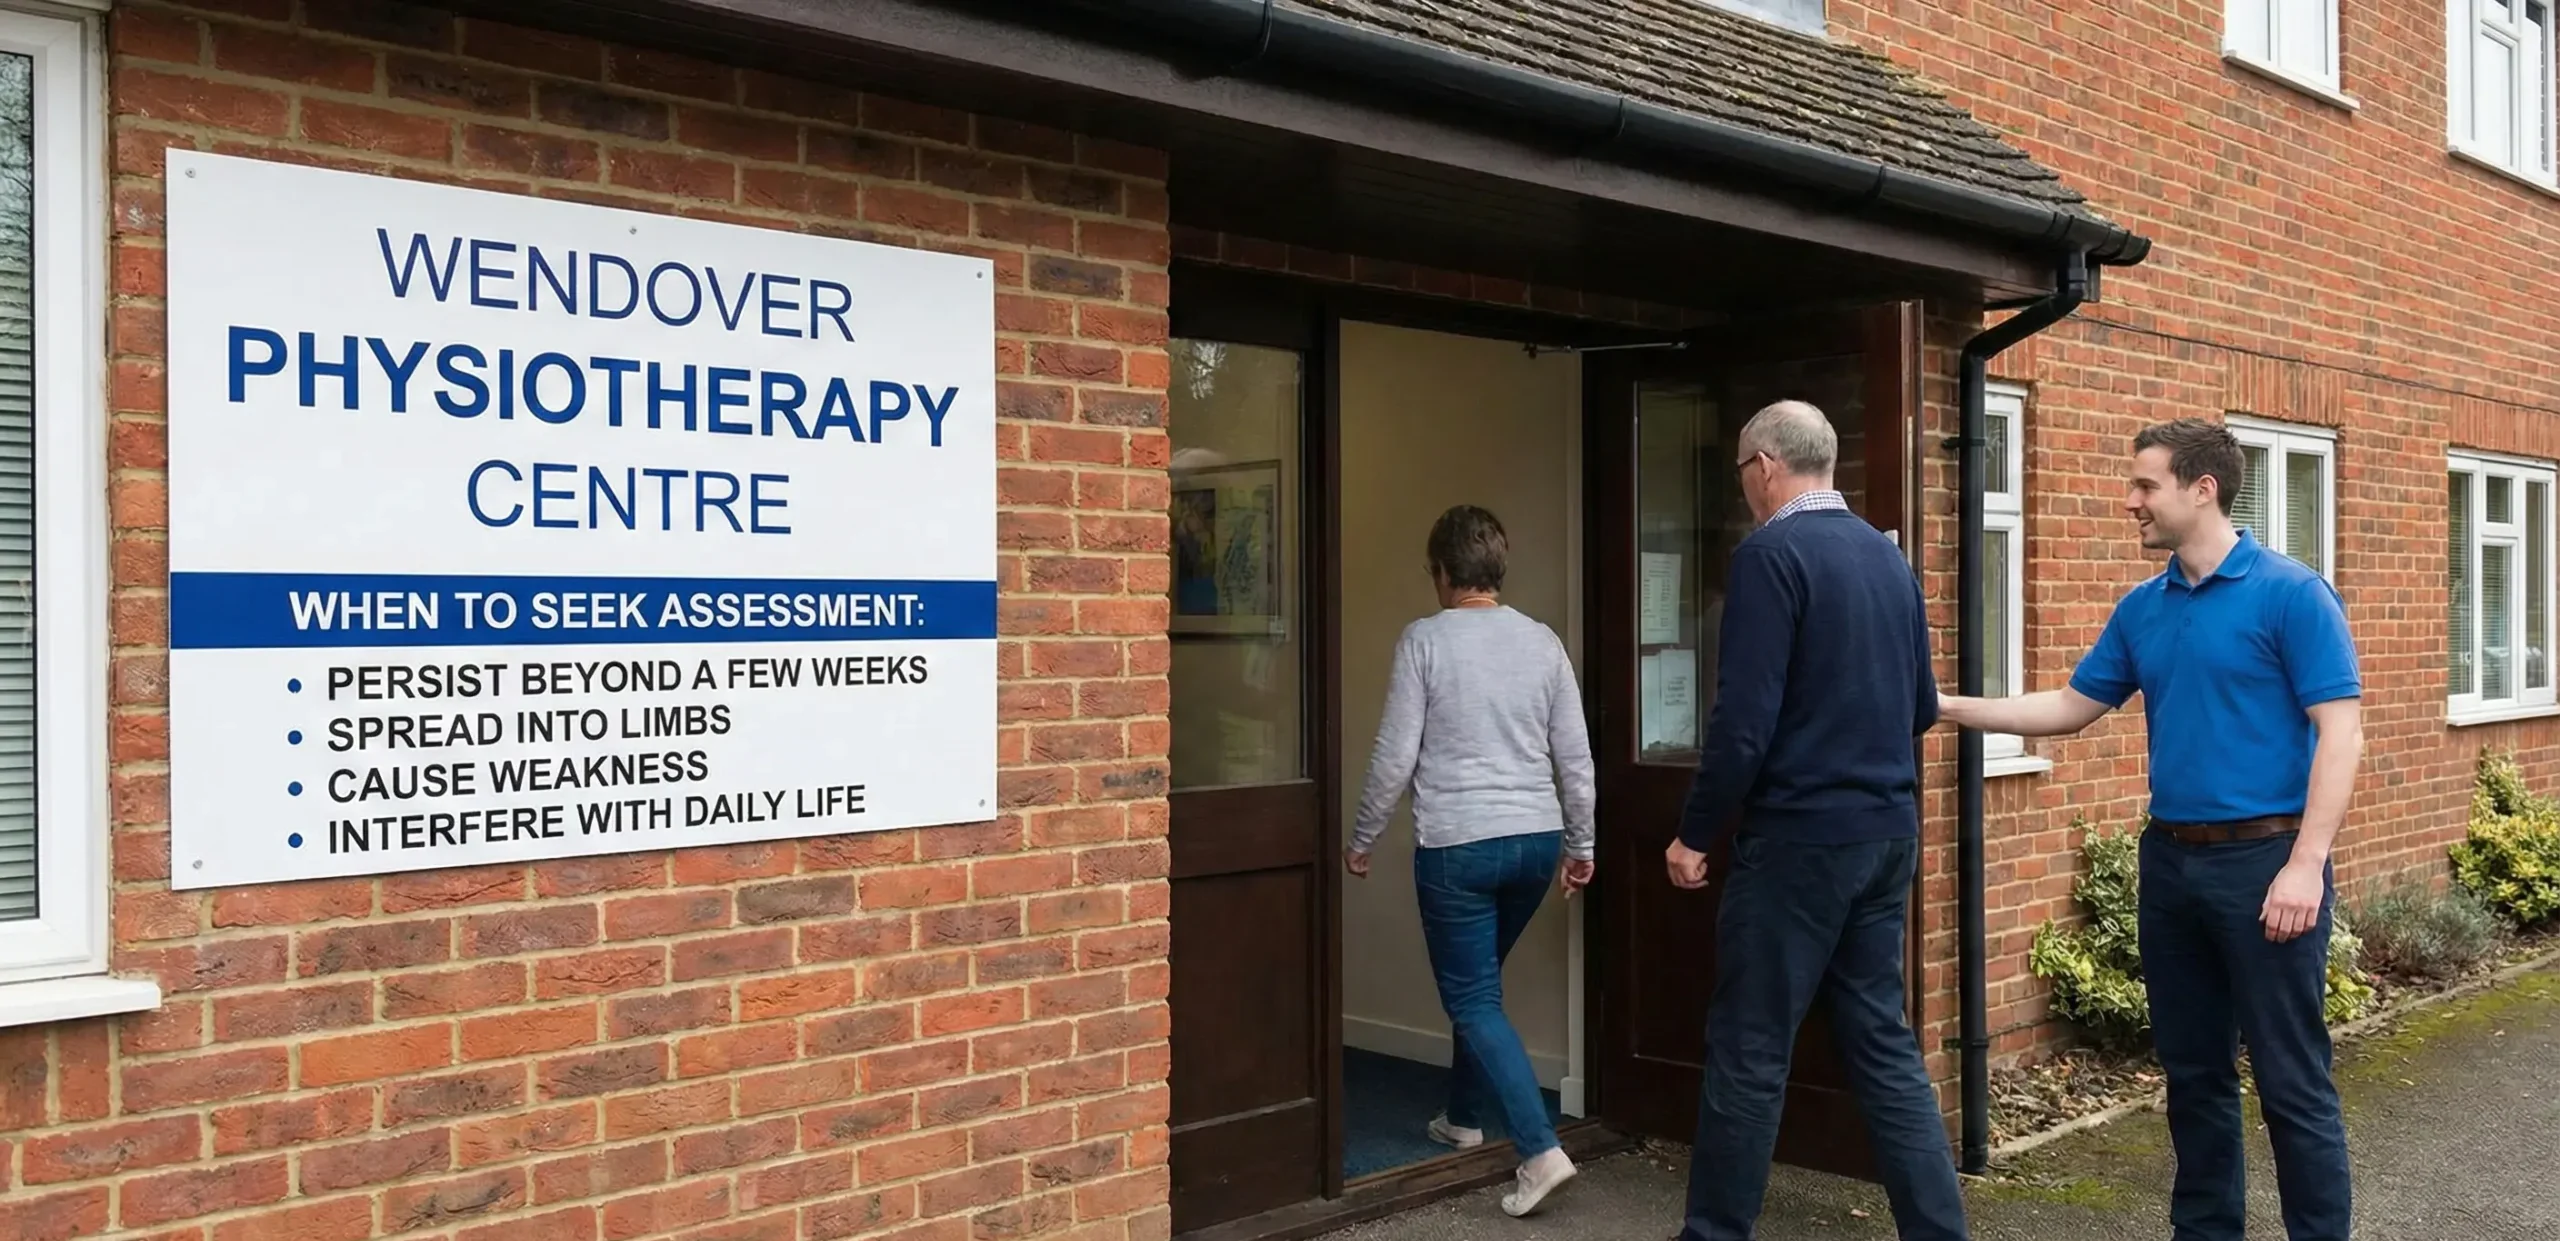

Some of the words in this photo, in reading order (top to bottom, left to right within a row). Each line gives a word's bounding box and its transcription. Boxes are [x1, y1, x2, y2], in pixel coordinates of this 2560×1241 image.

[378, 227, 855, 343] WENDOVER
[227, 325, 960, 448] PHYSIOTHERAPY
[467, 459, 792, 535] CENTRE
[288, 591, 439, 630] WHEN
[454, 592, 517, 629] TO
[531, 592, 649, 629] SEEK
[657, 592, 924, 628] ASSESSMENT:
[328, 663, 508, 701] PERSIST
[522, 660, 682, 696] BEYOND
[691, 659, 718, 690] A
[728, 657, 803, 689] FEW
[811, 655, 928, 687] WEEKS
[327, 712, 503, 753] SPREAD
[517, 708, 608, 744] INTO
[621, 704, 731, 739] LIMBS
[328, 762, 476, 804] CAUSE
[488, 750, 709, 794] WEAKNESS
[329, 805, 565, 854] INTERFERE
[576, 797, 672, 835] WITH
[685, 790, 786, 827] DAILY
[797, 784, 866, 819] LIFE
